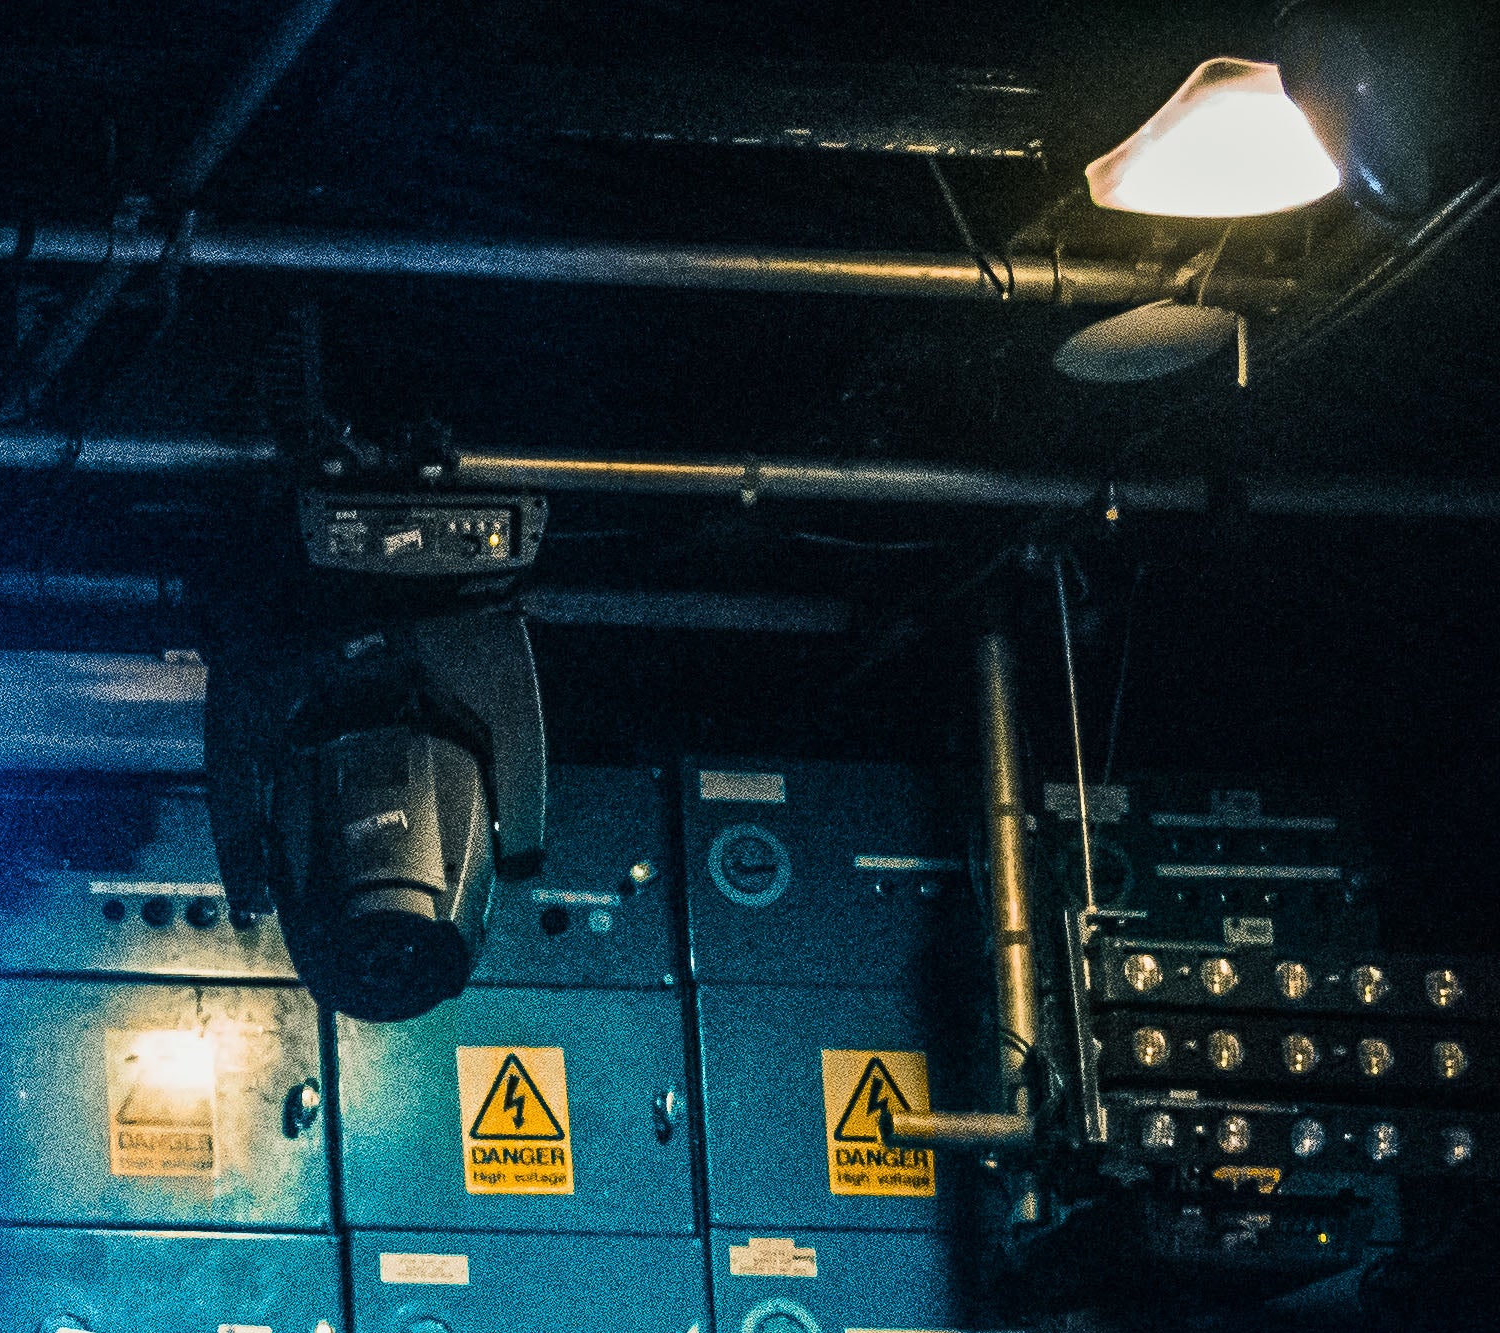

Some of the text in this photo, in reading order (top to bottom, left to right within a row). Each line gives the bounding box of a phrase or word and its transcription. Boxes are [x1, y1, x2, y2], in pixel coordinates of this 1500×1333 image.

[471, 1147, 565, 1166] DANGER
[835, 1148, 930, 1169] DANGER
[473, 1171, 567, 1185] High voltage
